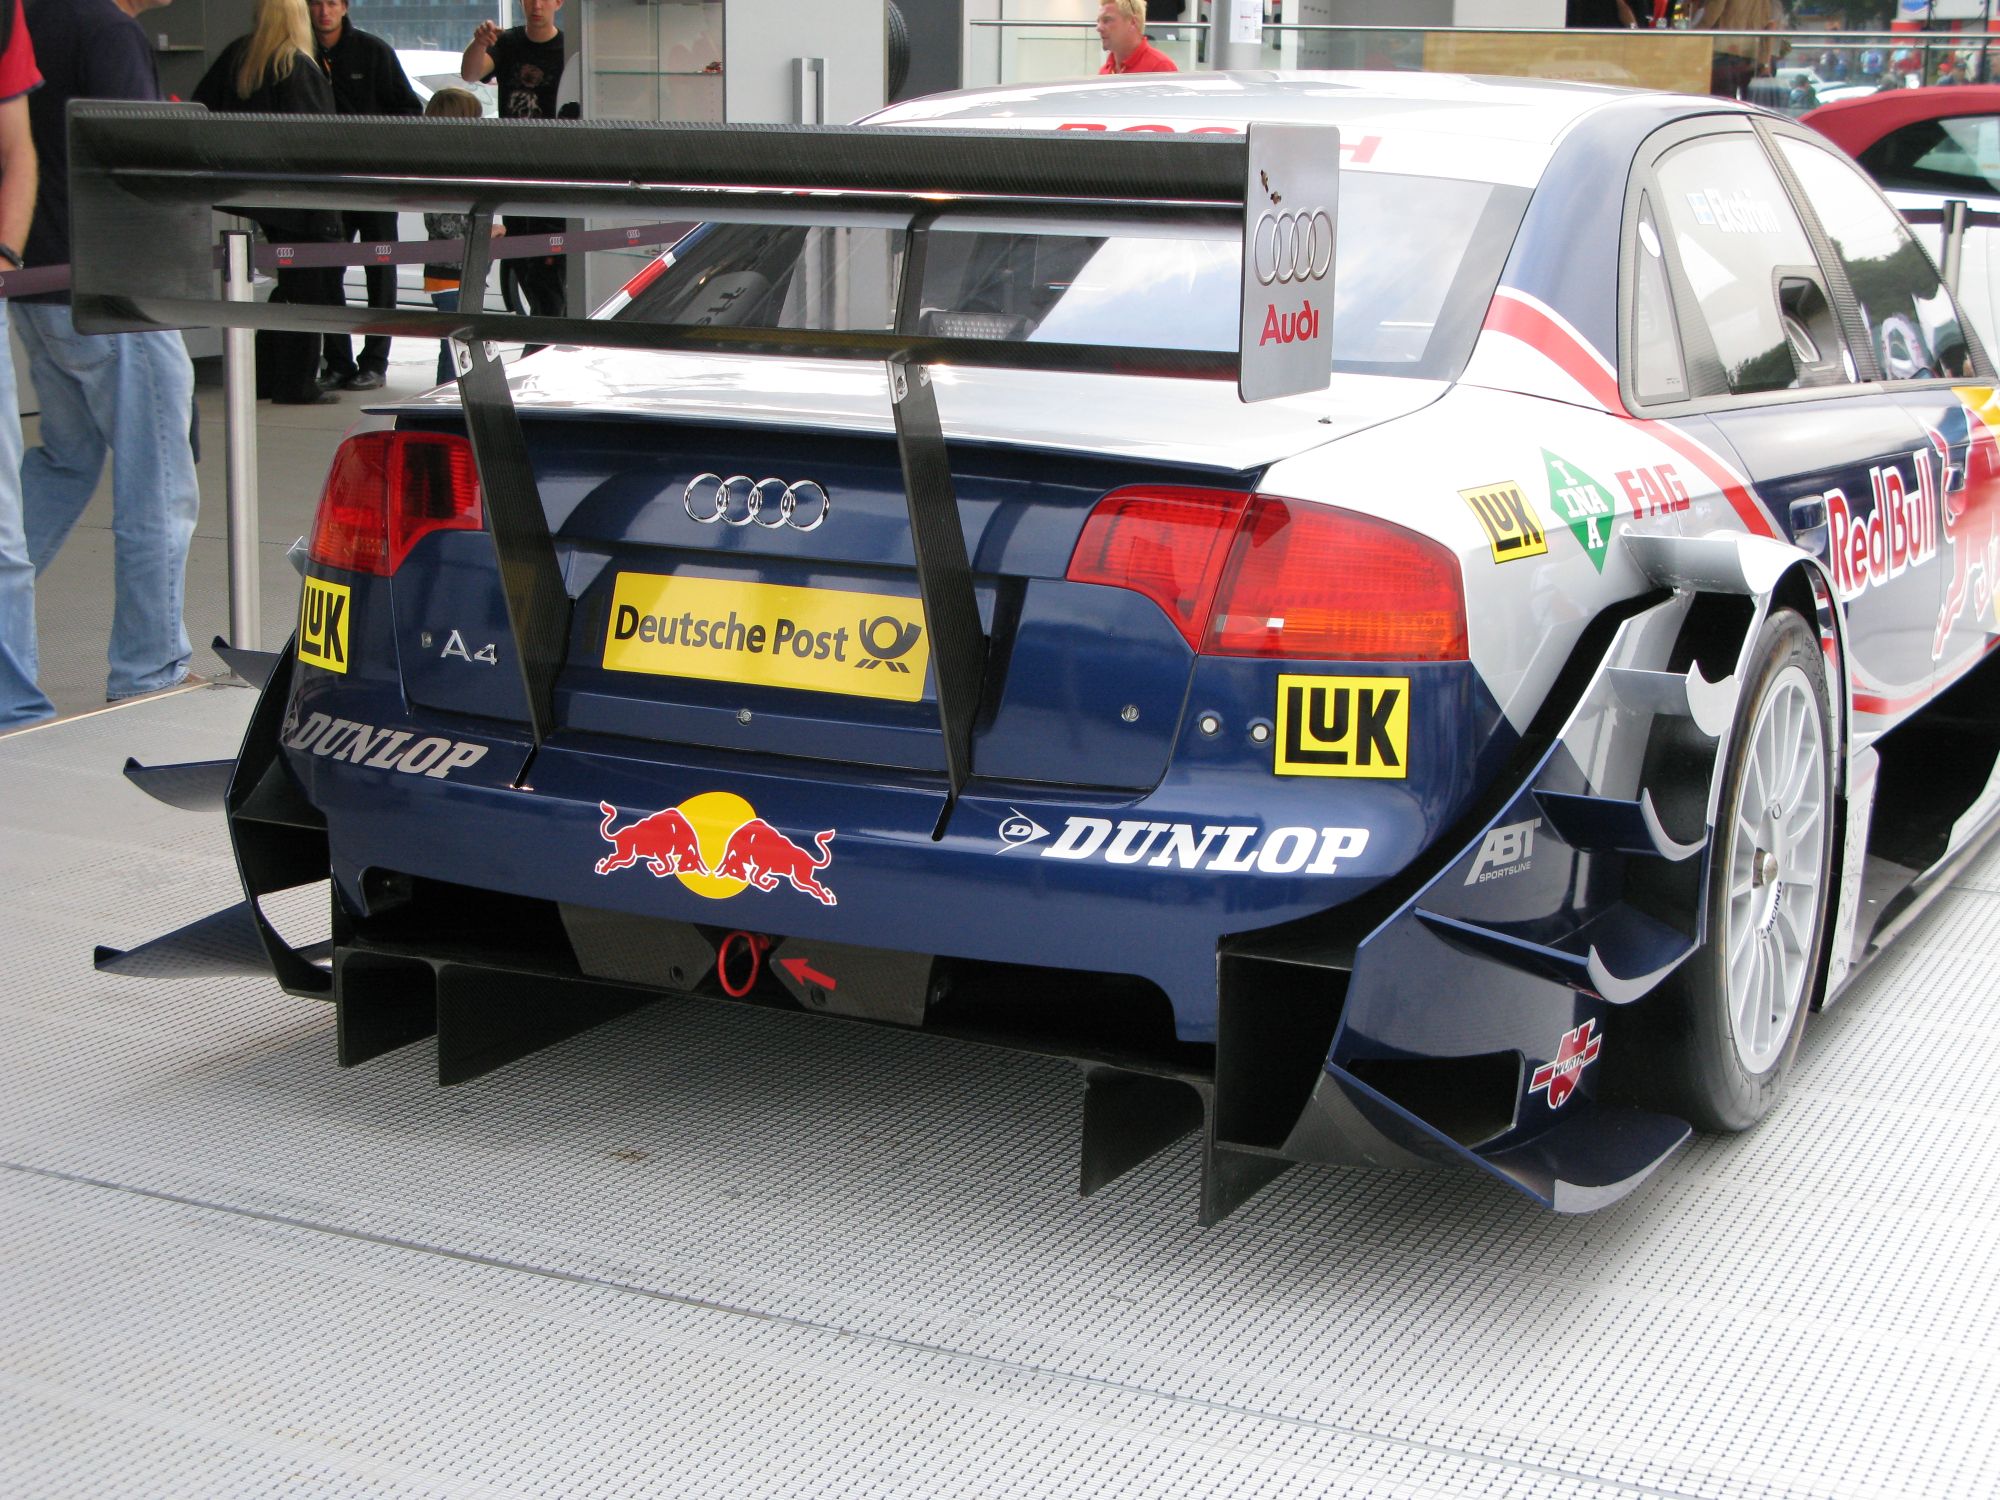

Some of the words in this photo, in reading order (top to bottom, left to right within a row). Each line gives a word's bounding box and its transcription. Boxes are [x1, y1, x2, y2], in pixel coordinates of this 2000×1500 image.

[1259, 299, 1319, 347] Audi
[1614, 463, 1690, 520] FAG
[1825, 467, 1887, 595] Red
[1883, 448, 1935, 576] Bull
[440, 629, 498, 666] A4
[614, 603, 767, 653] Deutsche
[772, 617, 850, 662] Post
[288, 711, 489, 780] DUNLOP
[1040, 816, 1370, 875] DUNLOP
[1463, 817, 1542, 886] ABT
[1479, 860, 1532, 883] SPORTSLINE
[1766, 881, 1782, 934] RACING
